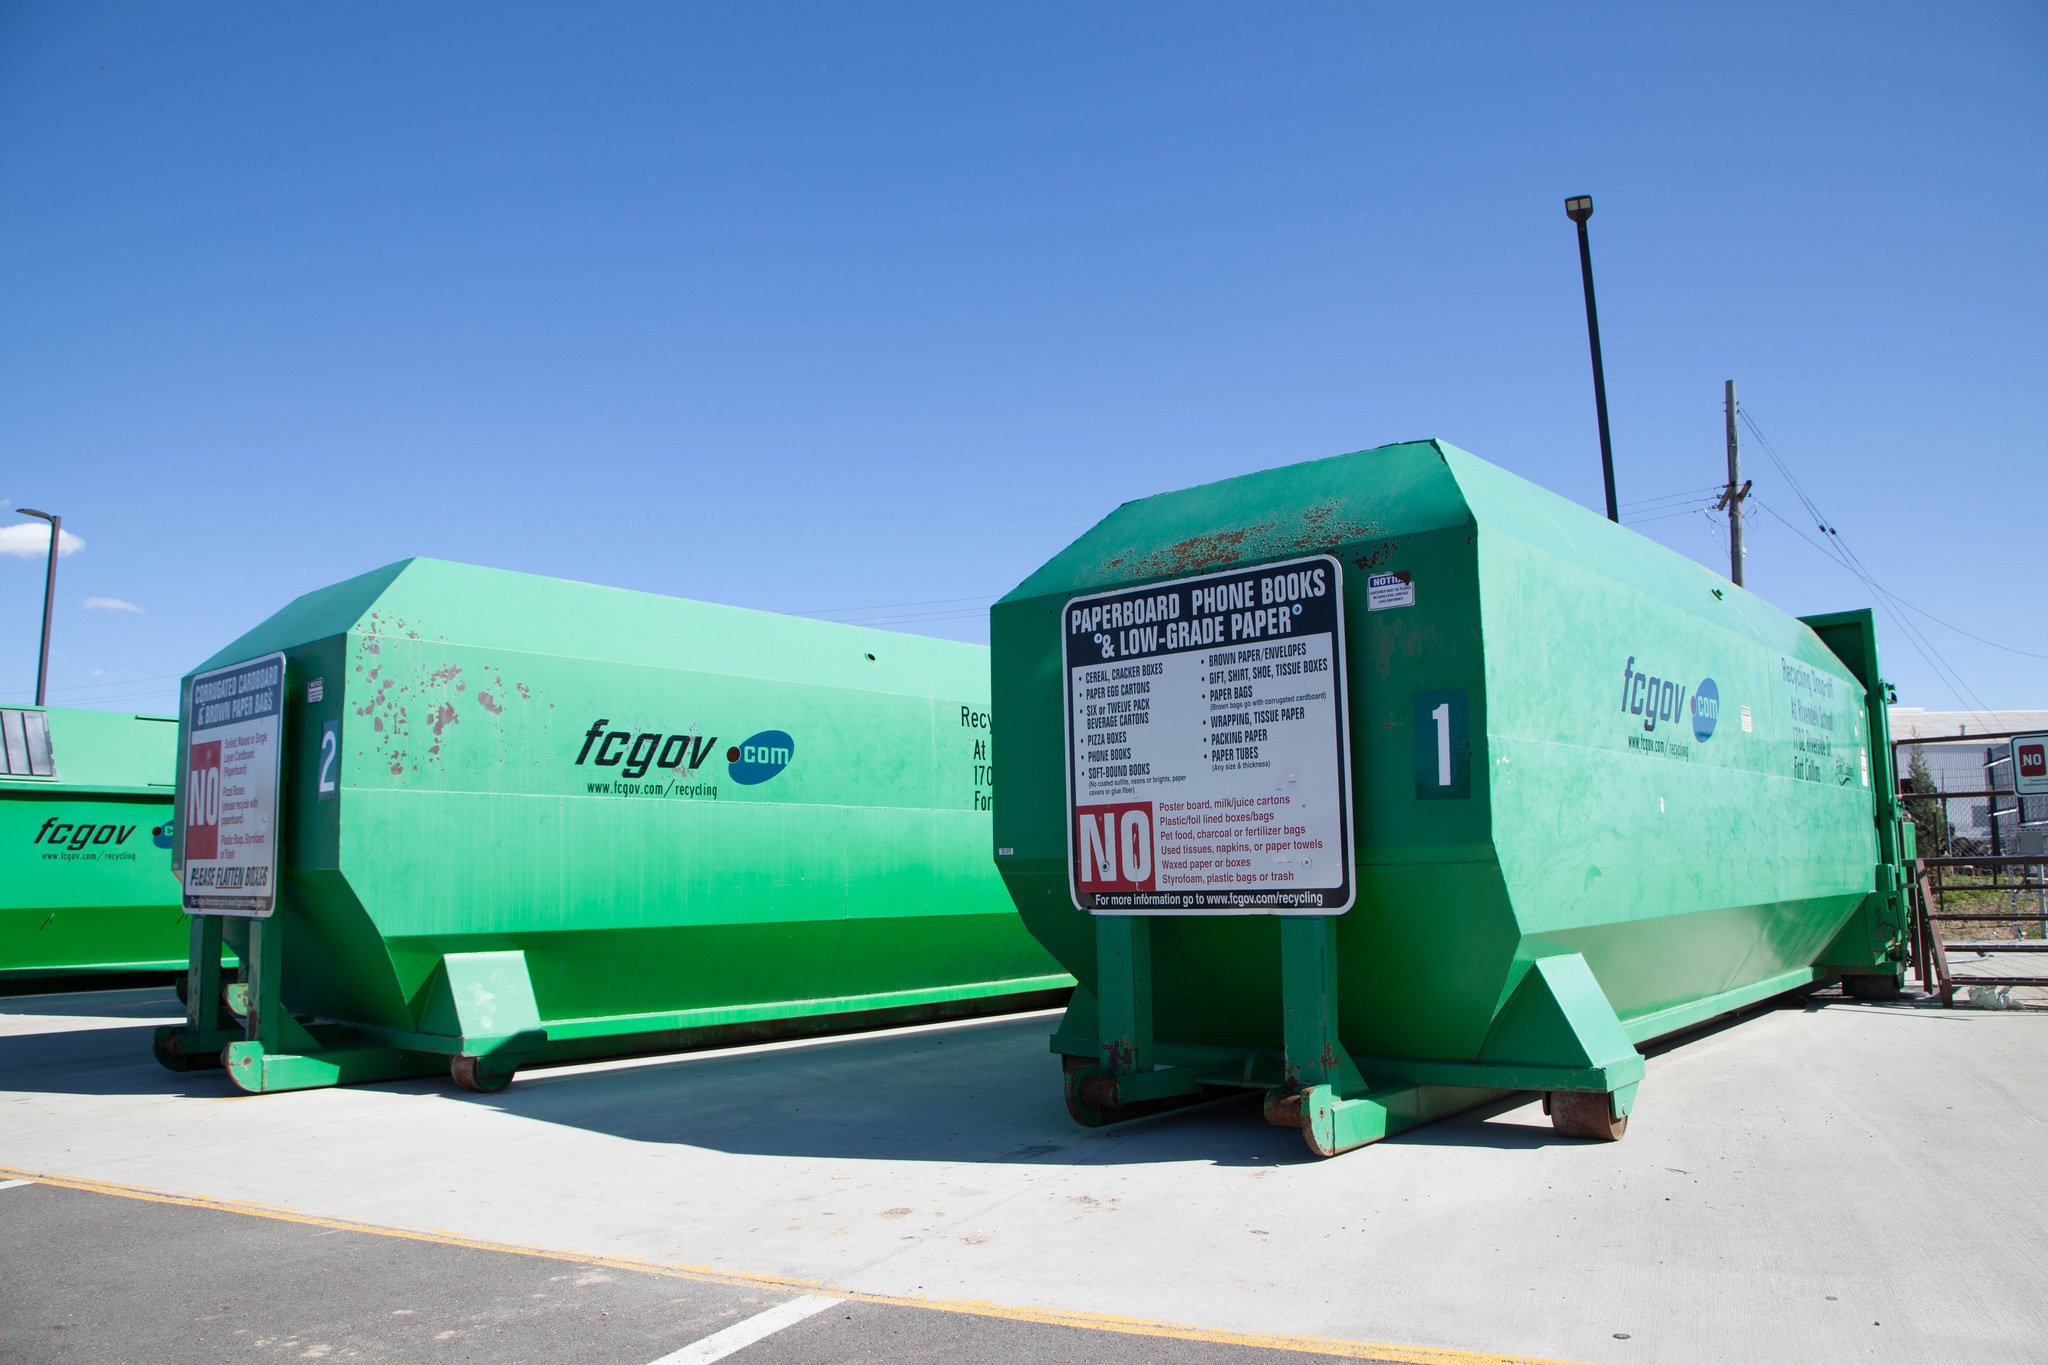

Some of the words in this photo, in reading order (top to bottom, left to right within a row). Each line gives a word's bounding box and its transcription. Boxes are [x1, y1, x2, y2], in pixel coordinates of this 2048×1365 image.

[1072, 594, 1179, 634] PAPERBOARD
[1192, 583, 1254, 615] PHONE
[1261, 569, 1325, 602] BOOKS
[1102, 635, 1115, 658] &
[1120, 616, 1224, 656] LOW-GRADE
[1231, 606, 1291, 641] PAPER
[1209, 652, 1236, 667] BROWN
[1238, 643, 1306, 663] PAPER/ENVELOPES
[1086, 669, 1110, 684] CEREAL,
[1112, 666, 1140, 680] CRACKER
[1142, 663, 1163, 676] BOXES
[1210, 671, 1226, 685] GIFT,
[1228, 668, 1251, 682] SHIRT,
[1253, 665, 1273, 680] SHOE,
[1276, 662, 1301, 676] TISSUE
[1303, 658, 1327, 673] BOXES
[195, 677, 237, 704] CORRUGATED
[238, 665, 278, 694] CARDBOARD
[1087, 688, 1105, 700] PAPER
[1107, 685, 1119, 697] EGG
[1121, 682, 1150, 696] CARTONS
[1210, 688, 1232, 701] PAPER
[1234, 685, 1252, 699] BAGS
[1210, 703, 1229, 712] (Brown
[1230, 702, 1243, 710] bags
[1244, 701, 1251, 709] go
[1265, 695, 1294, 706] corrugated
[1296, 692, 1326, 702] cardboard)
[1621, 656, 1686, 732] fcgov
[205, 701, 231, 724] BROWN
[232, 696, 253, 719] PAPER
[254, 691, 273, 714] BAGS
[1087, 705, 1097, 716] SIX
[1099, 706, 1105, 715] or
[1107, 701, 1131, 714] TWELVE
[1134, 699, 1150, 711] PACK
[1087, 716, 1117, 729] BEVERAGE
[1120, 712, 1149, 726] CARTONS
[1211, 713, 1252, 728] WRAPPING,
[1254, 709, 1279, 723] TISSUE
[1281, 707, 1305, 721] PAPER
[1088, 734, 1105, 746] PIZZA
[1107, 732, 1127, 744] BOXES
[1212, 731, 1242, 745] PACKING
[1245, 729, 1267, 743] PAPER
[1432, 704, 1451, 785] 1
[575, 719, 718, 779] fcgov
[973, 739, 986, 760] At
[1088, 750, 1108, 762] PHONE
[1111, 748, 1131, 761] BOOKS
[1212, 749, 1233, 762] PAPER
[1236, 747, 1258, 760] TUBES
[320, 730, 336, 792] 2
[1212, 763, 1224, 772] (Any
[1225, 762, 1236, 770] size
[1243, 760, 1270, 769] thickness)
[2022, 754, 2041, 766] NO
[1089, 765, 1127, 779] SOFT-BOUND
[1129, 763, 1150, 776] BOOKS
[189, 767, 219, 826] NO
[587, 779, 718, 798] www.fcgov.com/recycling
[1159, 802, 1184, 812] Poster
[1186, 800, 1212, 811] board,
[1214, 797, 1254, 810] milk/juice
[1257, 795, 1290, 806] cartons
[1160, 815, 1200, 826] Plastic/foil
[1203, 813, 1223, 823] lined
[1225, 811, 1274, 822] boxes/bags
[33, 817, 137, 850] fcgov
[1160, 831, 1173, 841] Pet
[1175, 830, 1195, 841] food,
[1197, 828, 1232, 839] charcoal
[1234, 829, 1243, 837] or
[1245, 825, 1281, 836] fertilizer
[1284, 824, 1305, 836] bags
[1080, 810, 1151, 882] NO
[1161, 845, 1181, 855] Used
[1183, 843, 1214, 854] tissues,
[1216, 842, 1252, 853] napkins,
[1254, 843, 1263, 851] or
[1266, 842, 1290, 852] paper
[1294, 838, 1323, 849] towels
[42, 851, 136, 862] www.fcgov.com/recycling
[1161, 859, 1188, 869] Waxed
[1190, 860, 1212, 870] paper
[1226, 857, 1250, 867] boxes
[191, 867, 215, 886] PLEASE
[215, 866, 245, 886] FLATTEN
[245, 866, 269, 887] BOXES
[1162, 873, 1204, 885] Styrofoam,
[1207, 871, 1233, 885] plastic
[1236, 871, 1256, 883] bags
[1260, 872, 1268, 881] or
[1271, 870, 1294, 881] trash
[1095, 894, 1108, 905] For
[1111, 896, 1131, 905] more
[1134, 893, 1180, 905] information
[1183, 896, 1194, 907] go
[1196, 894, 1204, 905] to
[1207, 892, 1323, 908] www.fcgov.com/recycling
